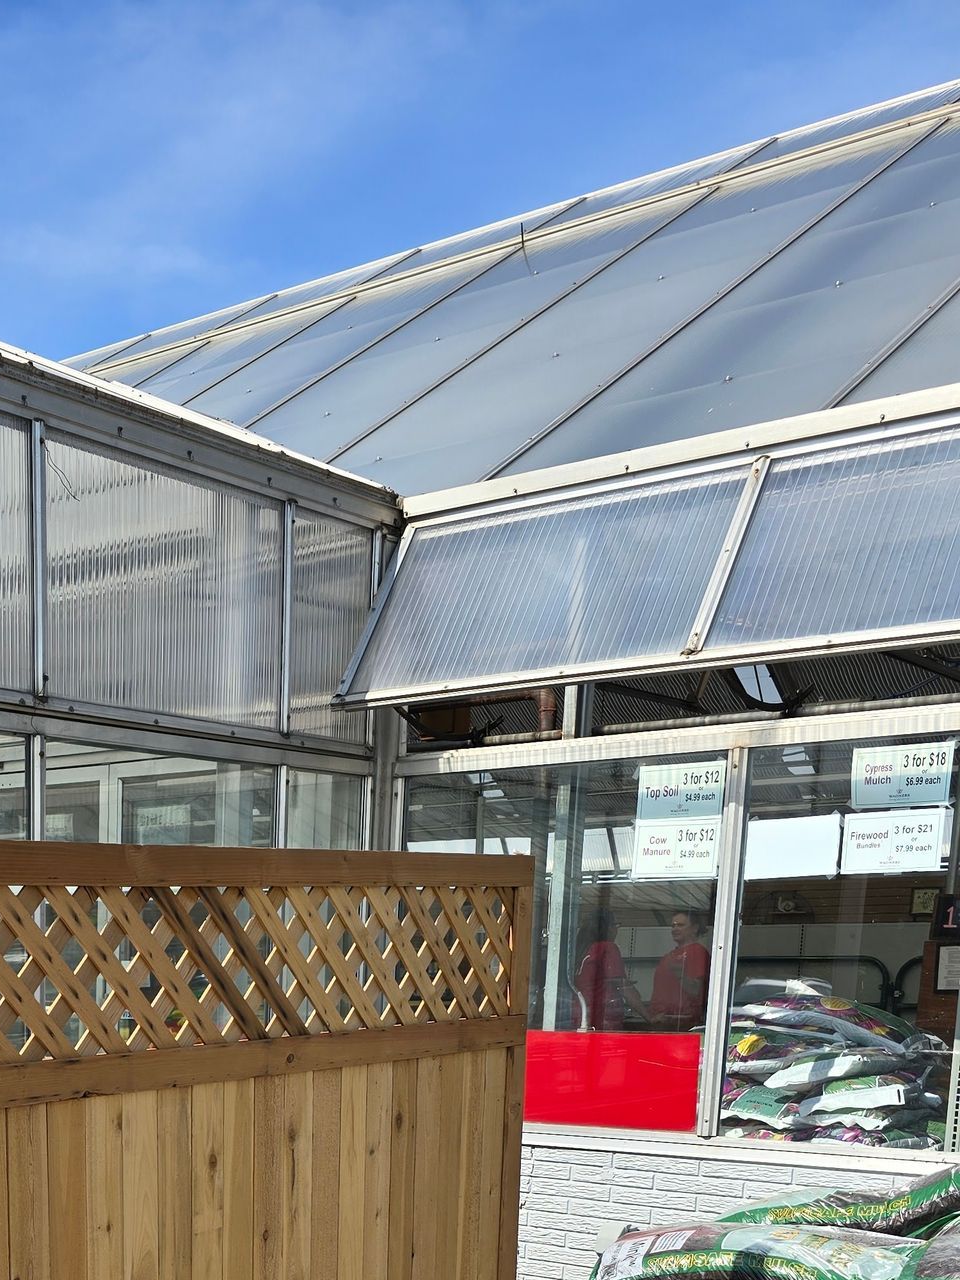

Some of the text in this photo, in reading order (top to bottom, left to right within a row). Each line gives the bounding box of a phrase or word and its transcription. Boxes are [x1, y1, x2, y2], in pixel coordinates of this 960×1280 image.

[904, 752, 946, 768] 3 for $18
[864, 764, 893, 775] Cypress
[683, 770, 720, 785] 3 for $12
[864, 775, 892, 785] Mulch
[906, 776, 941, 786] $6.99 each
[645, 785, 679, 800] Top Soil
[685, 792, 715, 802] $4.99 each
[894, 824, 933, 834] 3 for $21
[678, 828, 714, 842] 3 for $12
[850, 830, 889, 840] Firewood
[649, 836, 667, 845] Cow
[643, 848, 671, 856] Manure
[680, 850, 710, 858] $4.99 each
